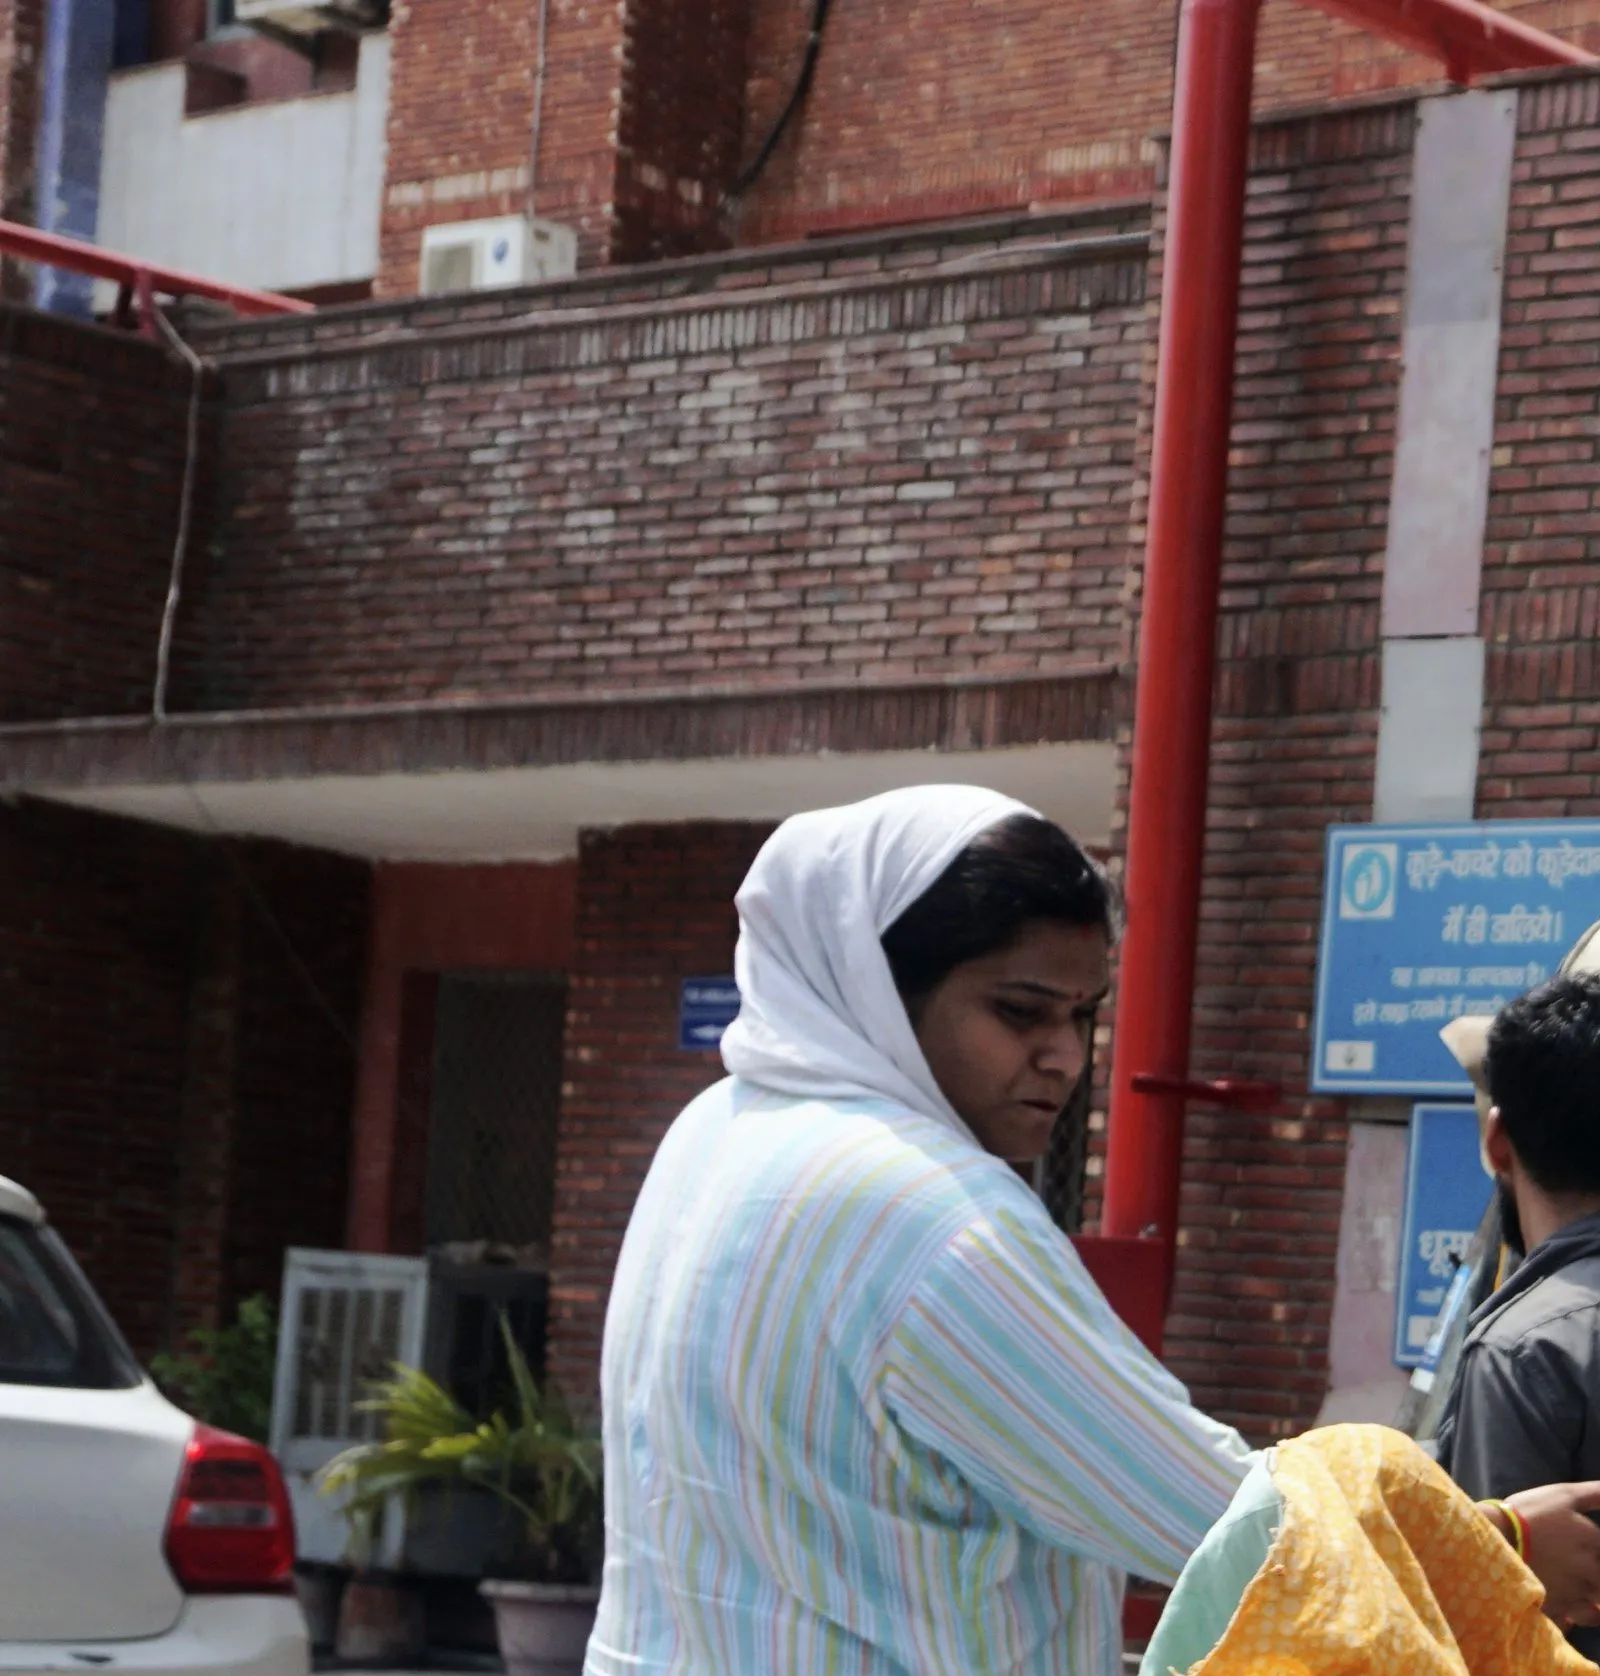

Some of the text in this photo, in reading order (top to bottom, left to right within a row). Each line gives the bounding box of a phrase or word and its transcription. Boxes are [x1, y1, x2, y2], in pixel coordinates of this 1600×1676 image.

[1503, 840, 1533, 878] को
[1441, 904, 1465, 943] में
[1465, 904, 1488, 945] ही
